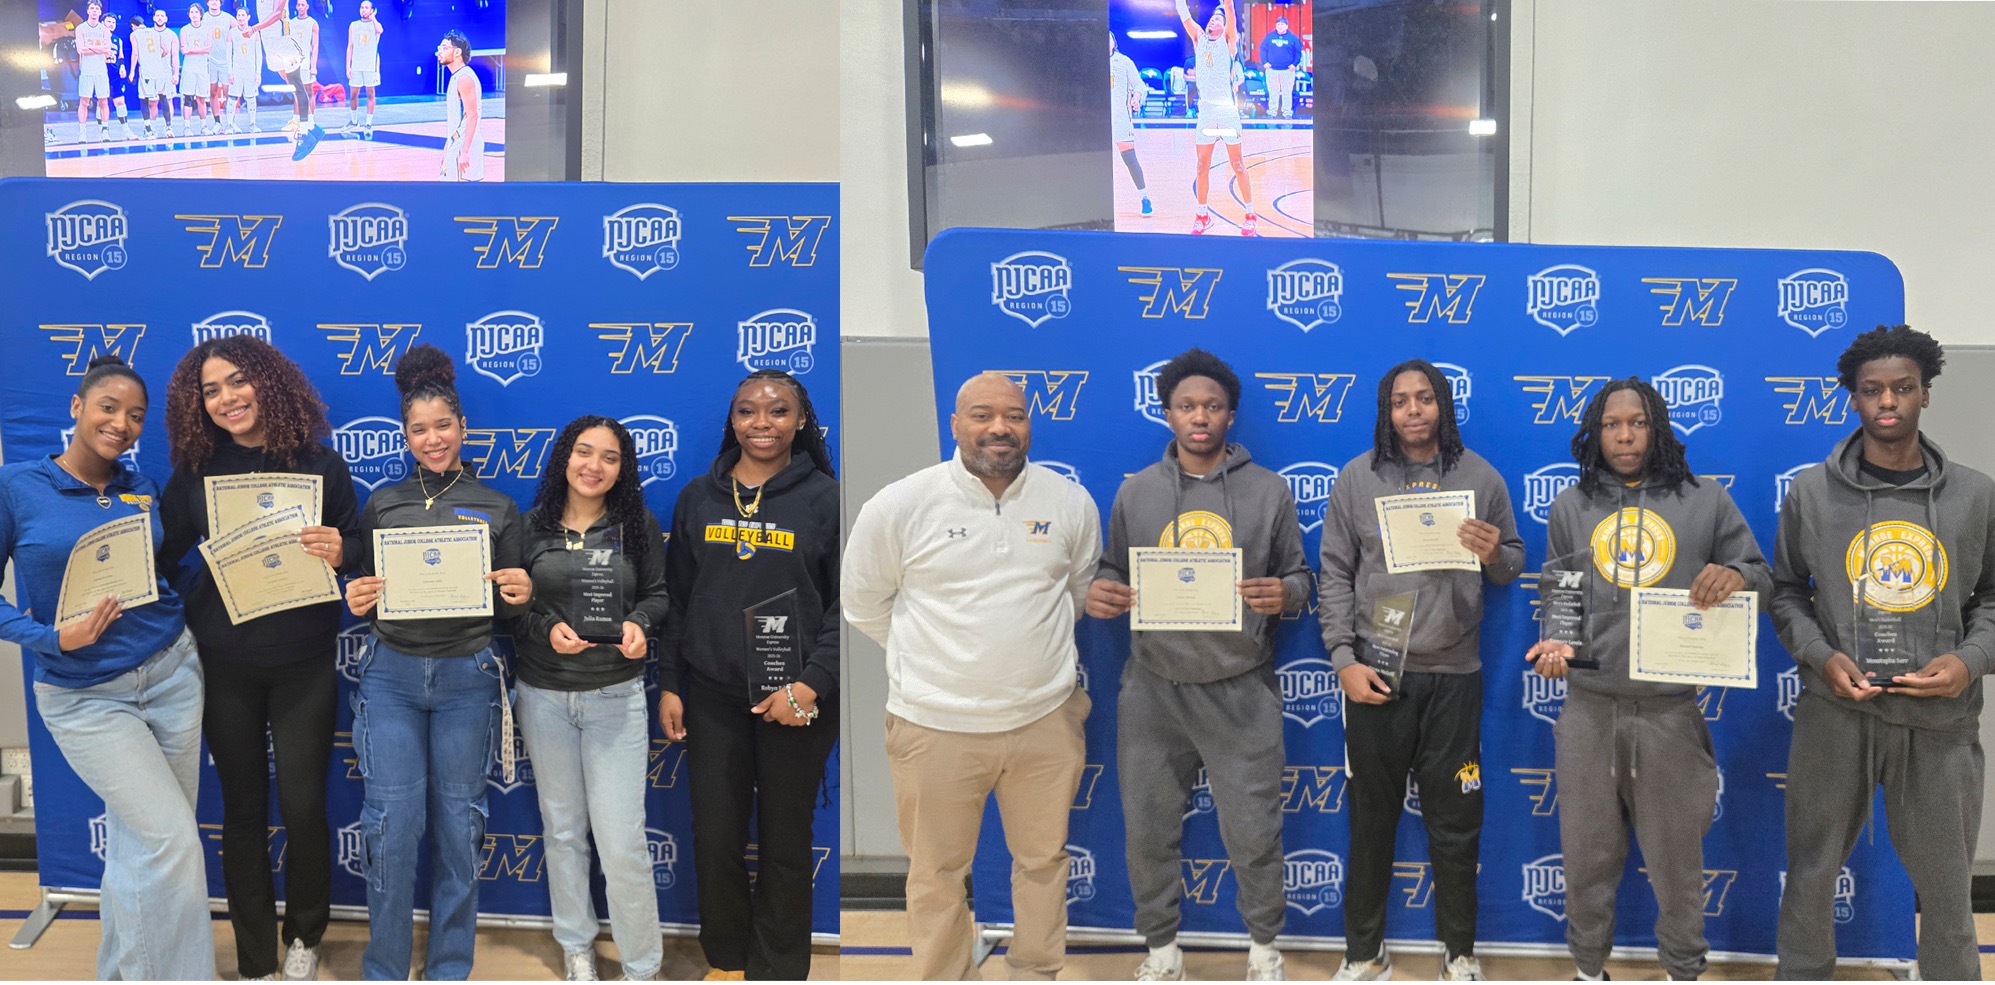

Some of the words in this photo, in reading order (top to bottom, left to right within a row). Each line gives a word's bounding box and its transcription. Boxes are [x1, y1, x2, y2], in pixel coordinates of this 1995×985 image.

[47, 214, 126, 256] NJCAA
[186, 215, 283, 268] M
[331, 215, 406, 256] NJCAA
[465, 216, 559, 268] M
[604, 216, 680, 256] NJCAA
[738, 216, 831, 267] M
[65, 253, 98, 261] REGION
[106, 250, 122, 264] 15
[346, 254, 378, 262] REGION
[386, 251, 402, 265] 15
[620, 254, 652, 262] REGION
[660, 251, 675, 264] 15
[995, 265, 1069, 301] NJCAA
[1130, 267, 1223, 319] M
[1270, 271, 1341, 305] NJCAA
[1397, 273, 1487, 324] M
[1530, 278, 1598, 310] NJCAA
[1781, 281, 1846, 312] NJCAA
[1051, 300, 1066, 312] 15
[1323, 306, 1337, 318] 15
[1579, 310, 1593, 321] 15
[1652, 278, 1738, 326] M
[1829, 312, 1843, 323] 15
[52, 324, 147, 376] M
[329, 324, 422, 375] M
[469, 323, 541, 362] NJCAA
[600, 323, 694, 374] M
[740, 321, 815, 360] NJCAA
[522, 358, 537, 370] 15
[794, 356, 809, 368] 15
[1267, 374, 1357, 422] M
[1703, 409, 1718, 420] 15
[335, 429, 405, 467] NJCAA
[468, 429, 557, 478] M
[388, 463, 403, 475] 15
[656, 462, 671, 474] 15
[1027, 521, 1051, 534] M
[584, 549, 613, 566] M
[1555, 570, 1583, 588] M
[757, 616, 788, 633] M
[1323, 702, 1337, 713] 15
[1196, 796, 1211, 806] 15
[1323, 891, 1337, 902] 15
[1834, 906, 1849, 917] 15
